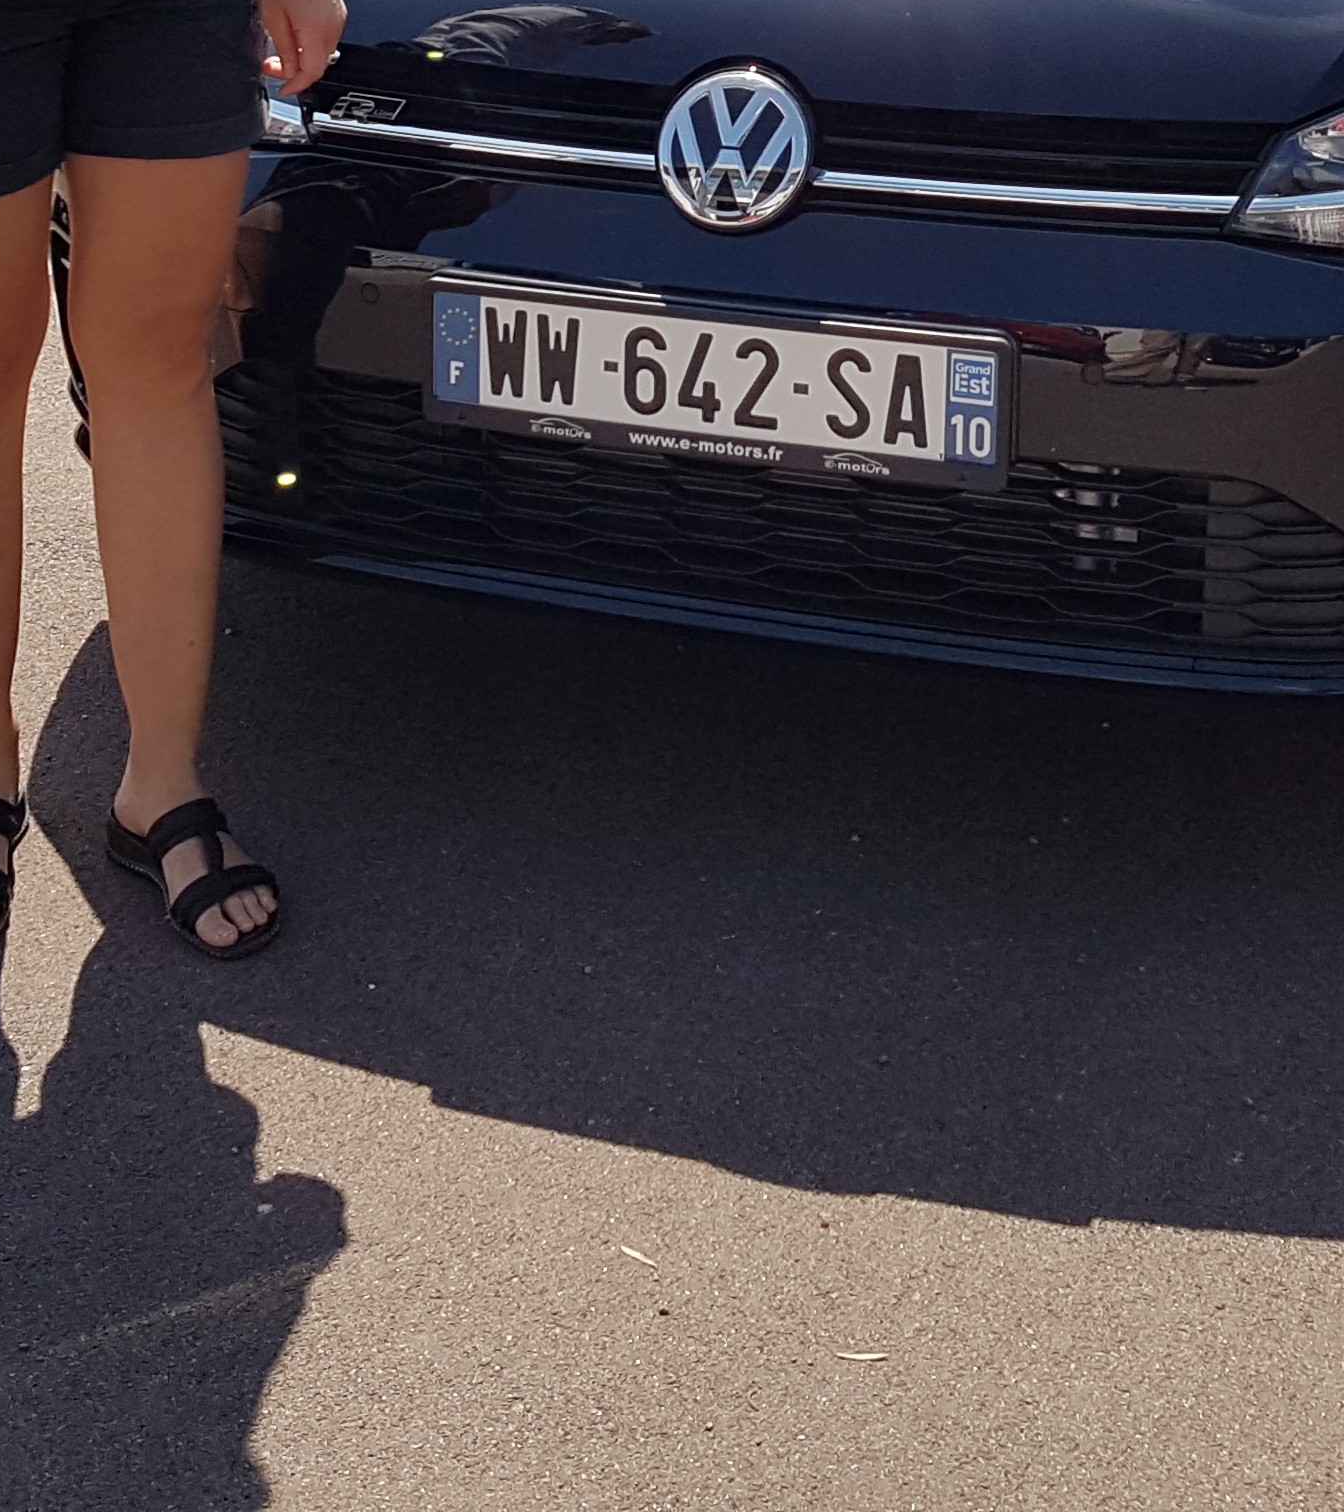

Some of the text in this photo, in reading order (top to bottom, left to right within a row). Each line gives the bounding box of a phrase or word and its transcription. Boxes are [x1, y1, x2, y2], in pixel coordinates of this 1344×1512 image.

[449, 360, 465, 385] F
[955, 362, 991, 376] Grand
[954, 372, 991, 396] Est
[628, 431, 784, 462] www.e-motors.fr
[950, 413, 992, 458] 10
